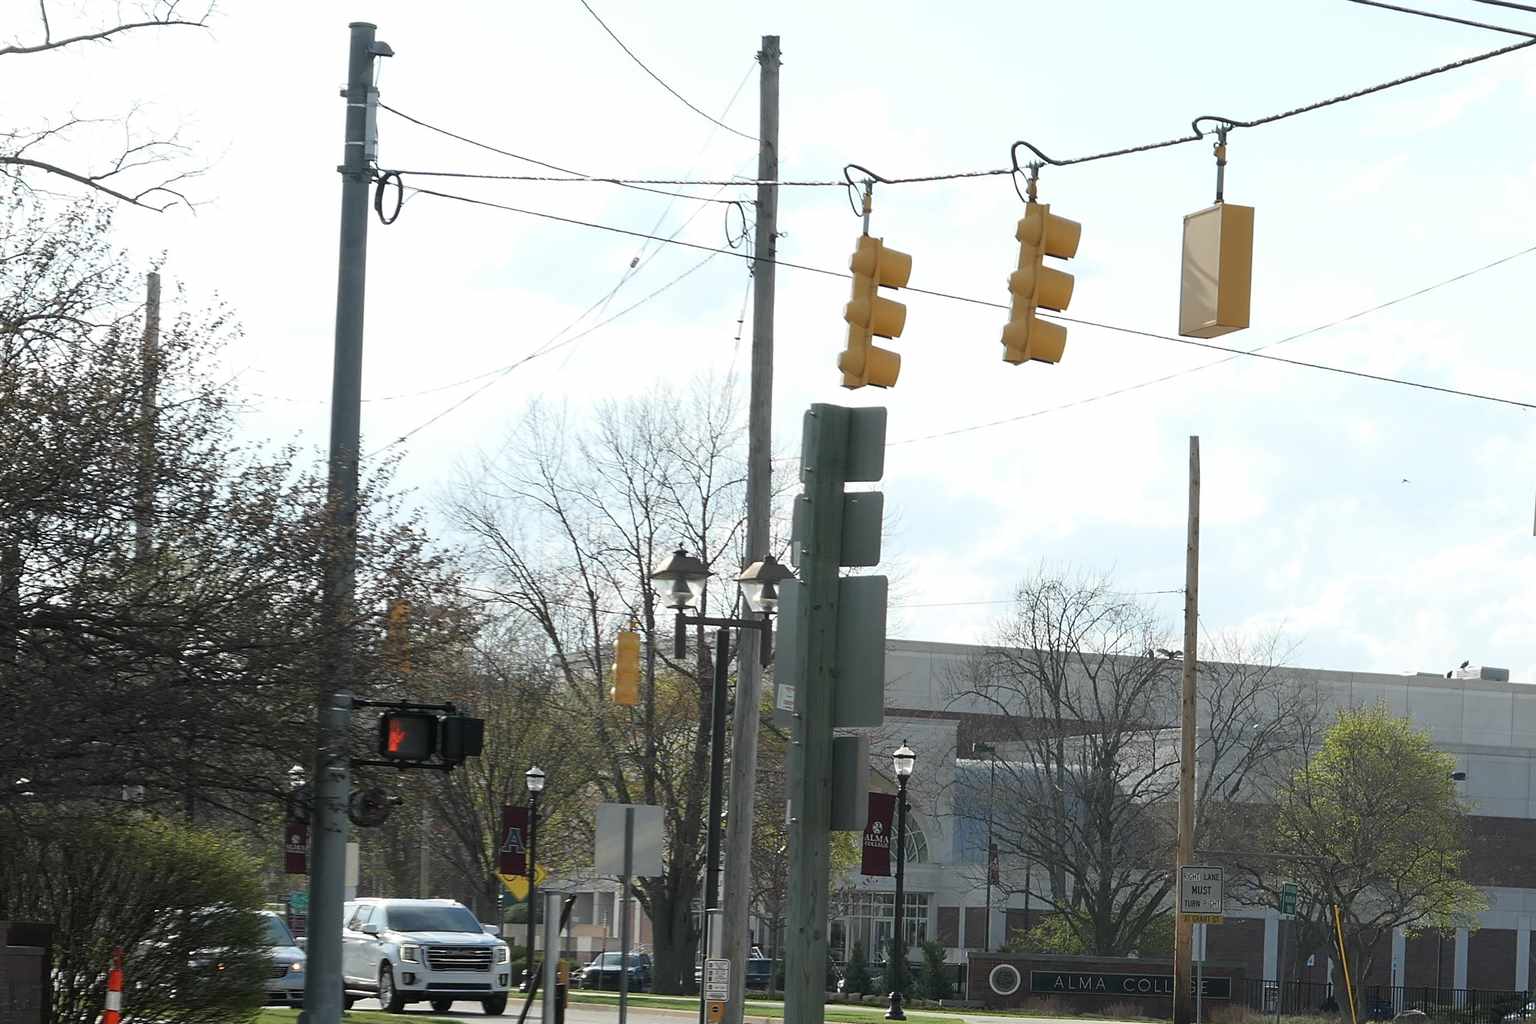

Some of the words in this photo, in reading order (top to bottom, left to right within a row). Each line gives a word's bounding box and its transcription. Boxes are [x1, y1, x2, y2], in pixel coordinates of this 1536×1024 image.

[501, 827, 525, 854] A
[864, 833, 889, 843] ALMA
[1191, 886, 1211, 895] MUST
[1053, 975, 1106, 991] ALMA
[1122, 977, 1209, 994] COLLGE
